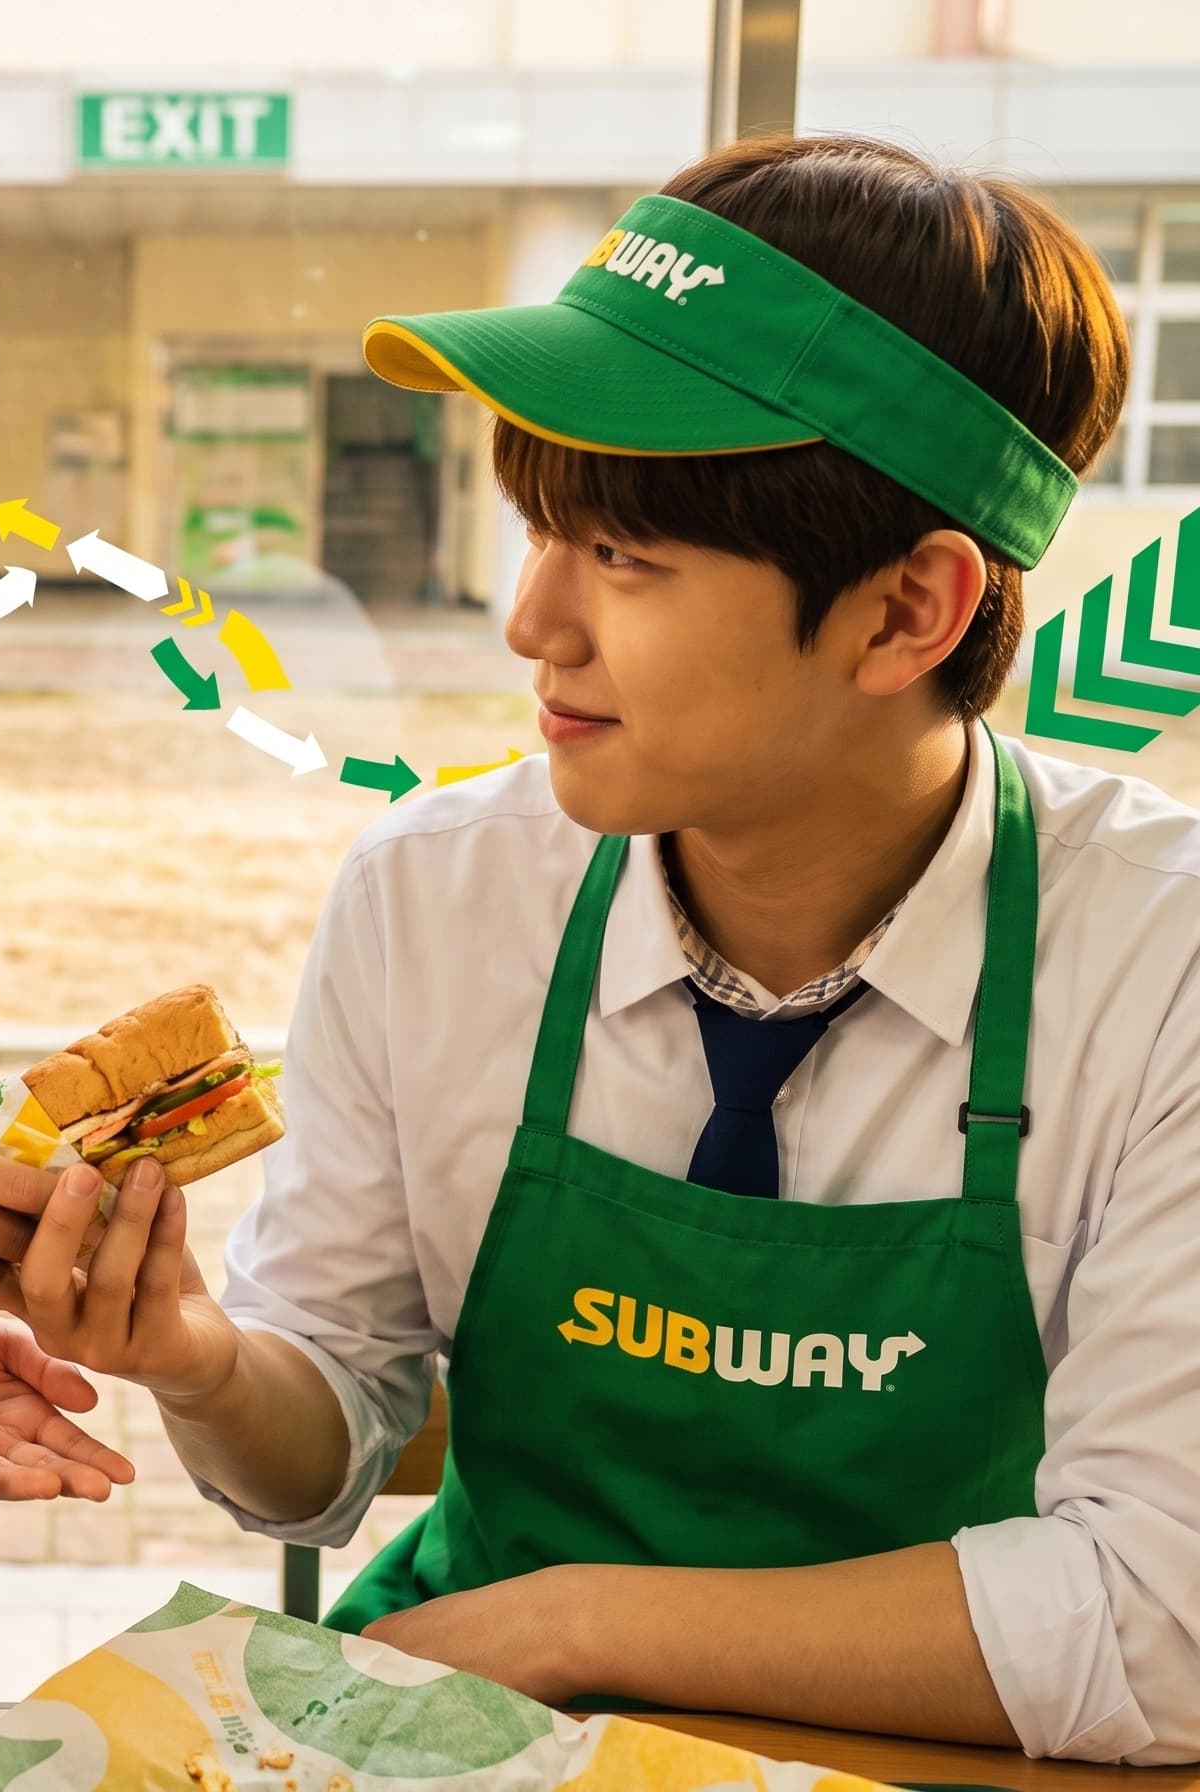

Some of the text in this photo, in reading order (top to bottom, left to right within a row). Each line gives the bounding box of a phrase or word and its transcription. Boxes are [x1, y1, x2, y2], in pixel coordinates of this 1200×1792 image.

[102, 97, 272, 159] EXIT
[581, 229, 725, 302] BWAY
[557, 1287, 927, 1392] SUBWAY
